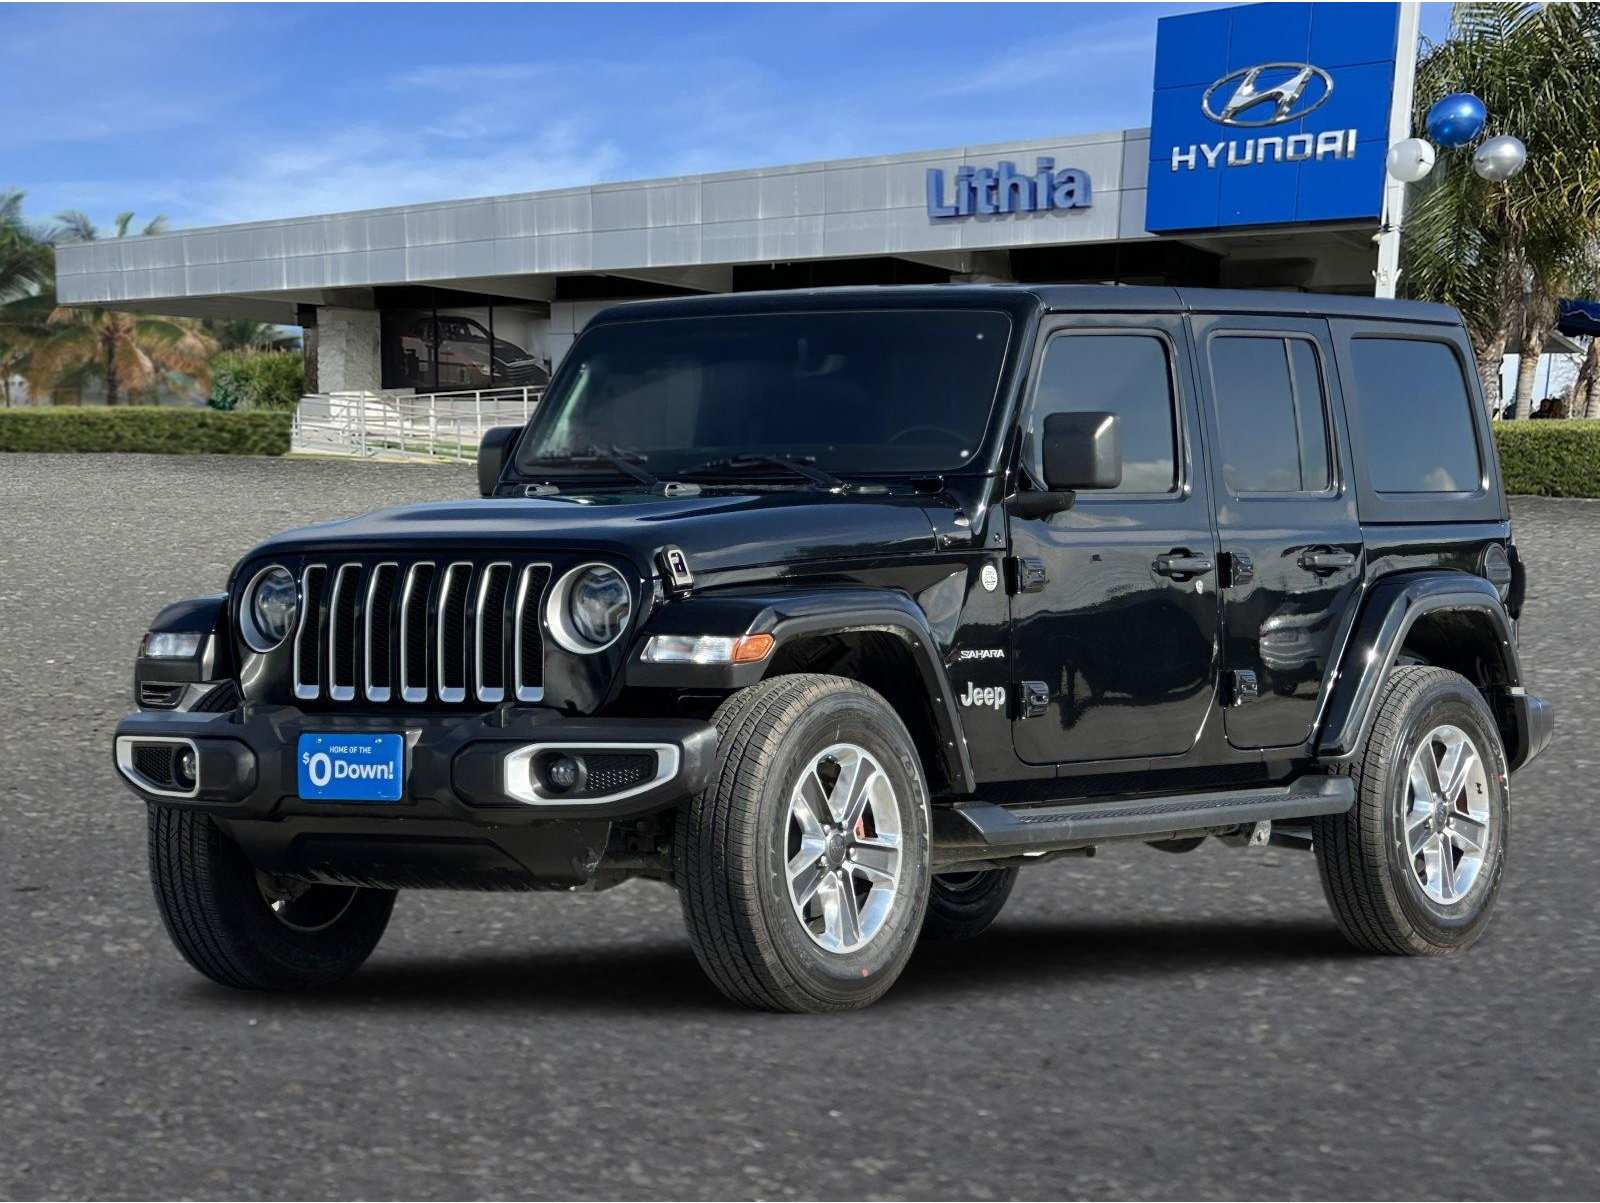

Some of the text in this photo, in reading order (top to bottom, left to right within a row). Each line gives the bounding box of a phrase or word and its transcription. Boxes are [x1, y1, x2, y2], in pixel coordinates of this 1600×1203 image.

[1171, 129, 1358, 172] HYUNDAI
[926, 156, 1092, 218] Lithia
[960, 649, 1005, 659] SAHARA
[960, 681, 1006, 710] Jeep
[329, 745, 372, 754] HOME OF THE
[334, 760, 394, 780] Down!
